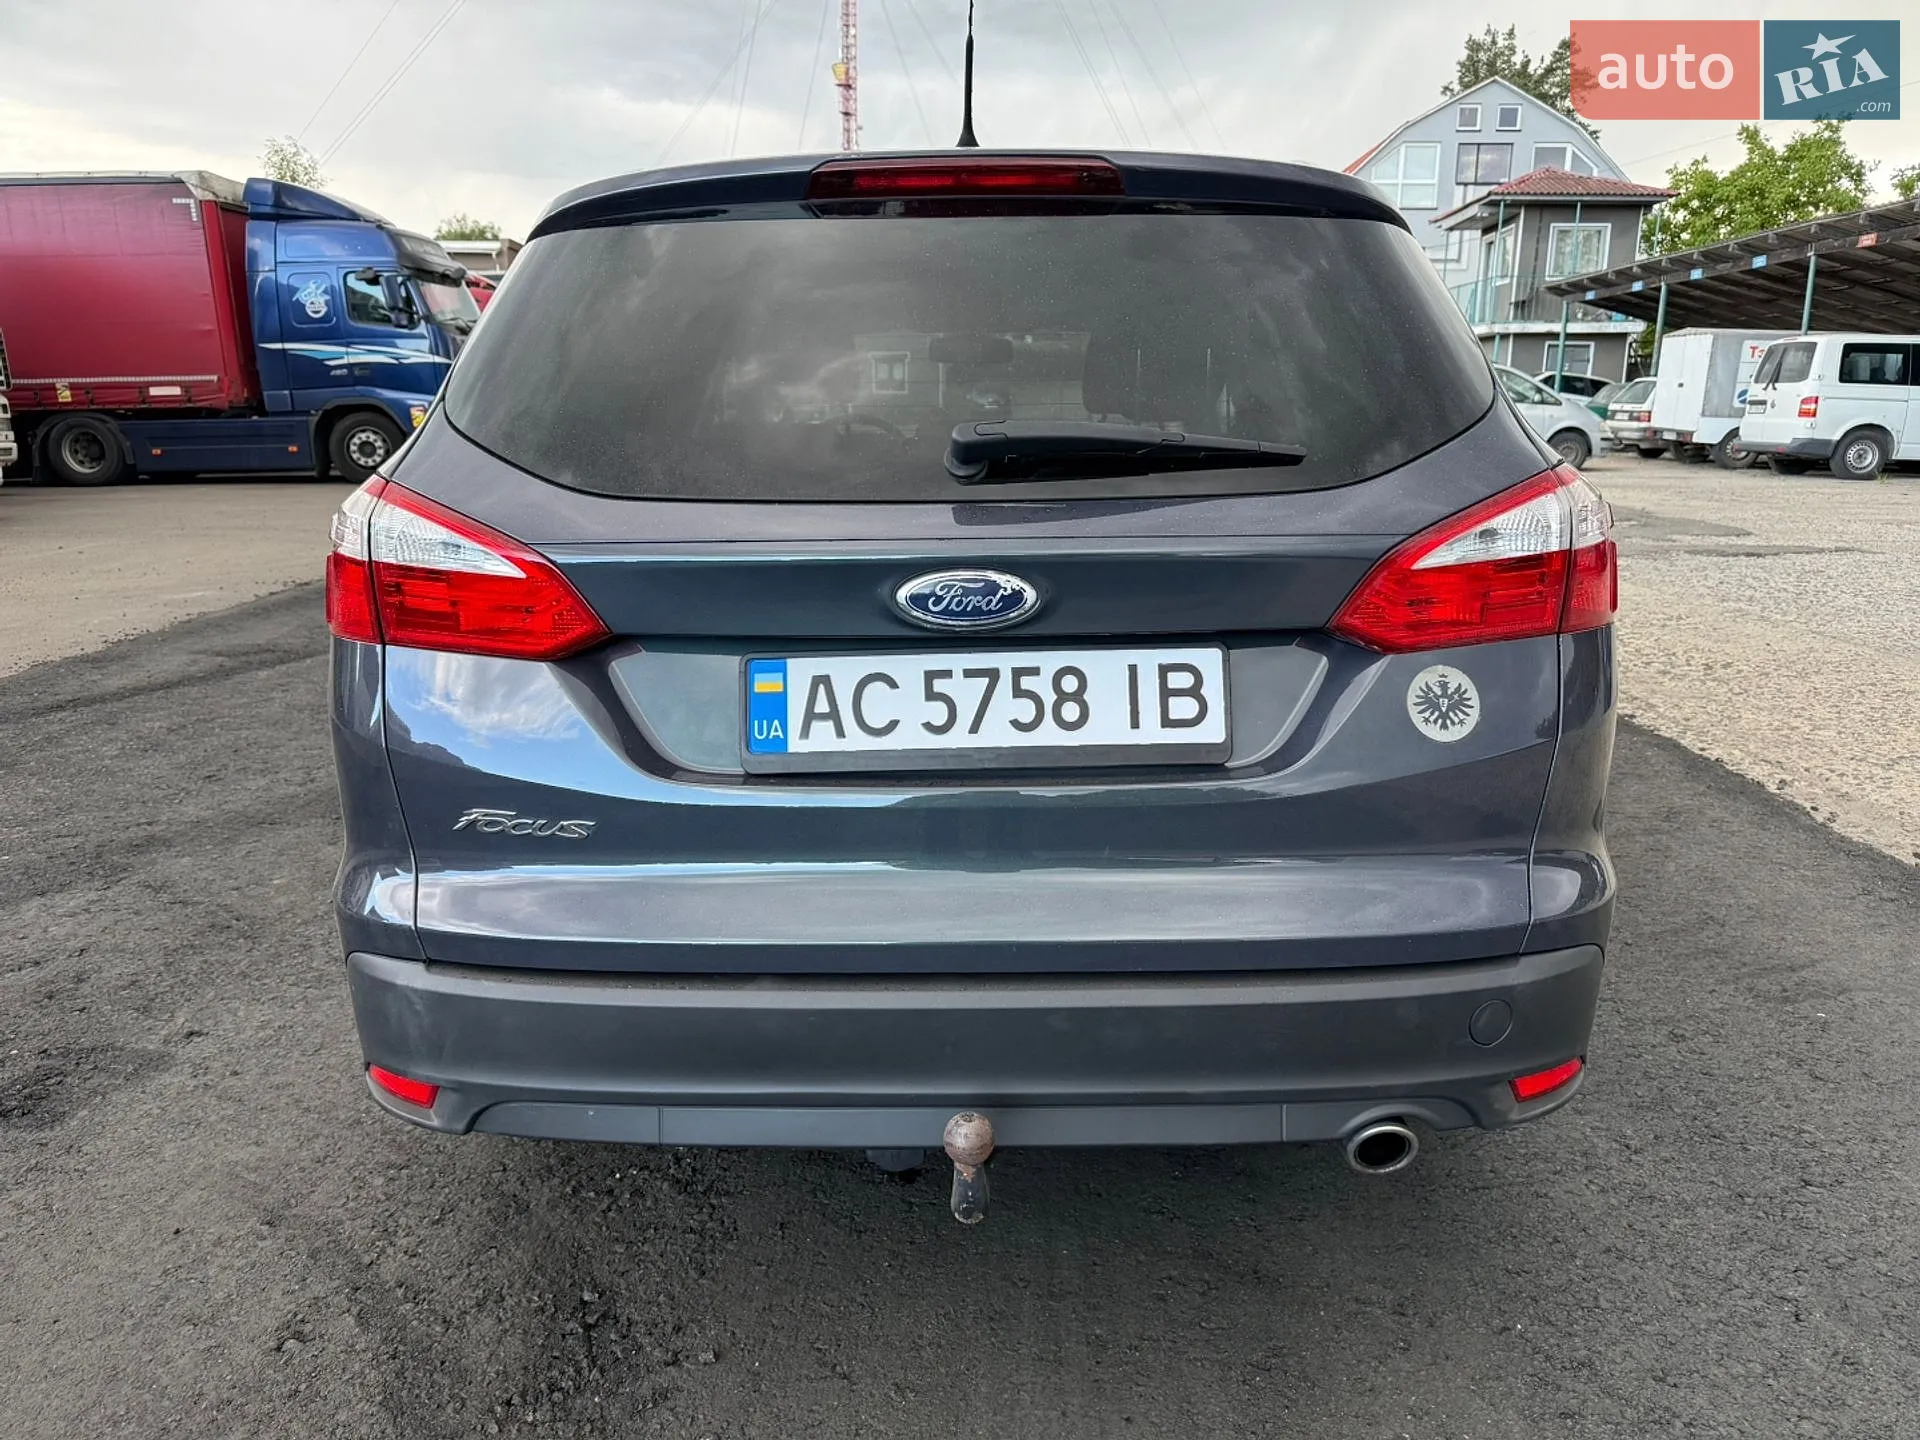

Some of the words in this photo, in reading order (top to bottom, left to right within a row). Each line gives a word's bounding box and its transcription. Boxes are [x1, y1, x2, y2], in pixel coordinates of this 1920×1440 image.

[928, 581, 1007, 612] Ford
[798, 671, 900, 741] AC
[920, 665, 1091, 736] 5758
[1127, 662, 1209, 730] IB
[754, 719, 784, 740] UA
